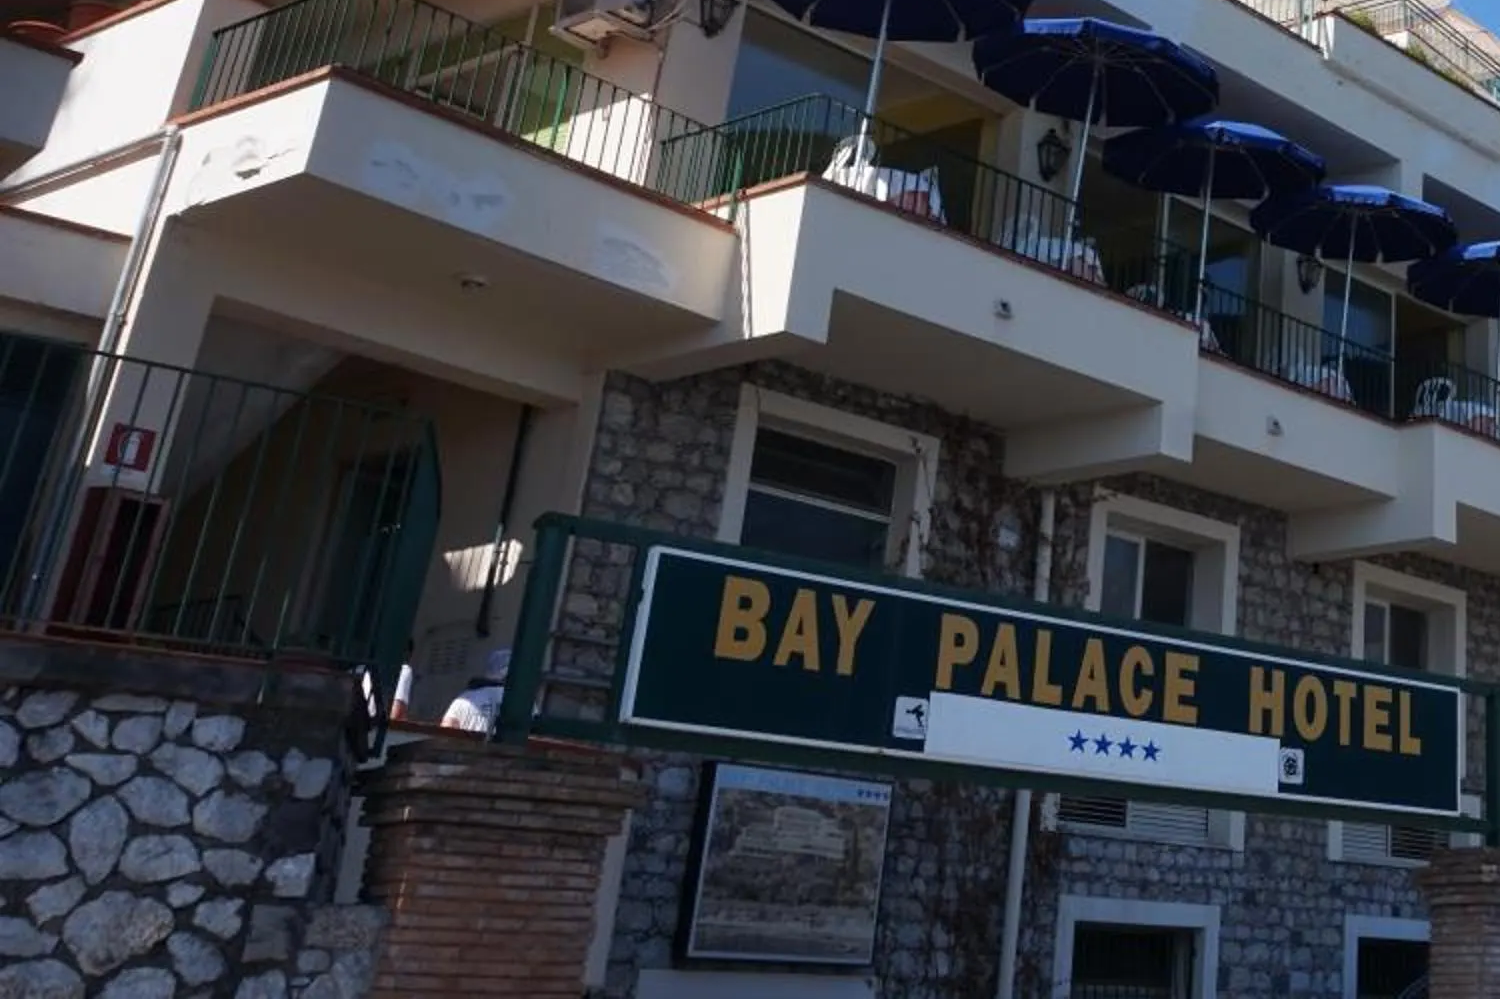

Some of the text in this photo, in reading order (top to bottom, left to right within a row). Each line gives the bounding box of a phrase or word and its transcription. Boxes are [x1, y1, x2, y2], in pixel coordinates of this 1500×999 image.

[714, 576, 1422, 756] BAY PALACE HOTEL
